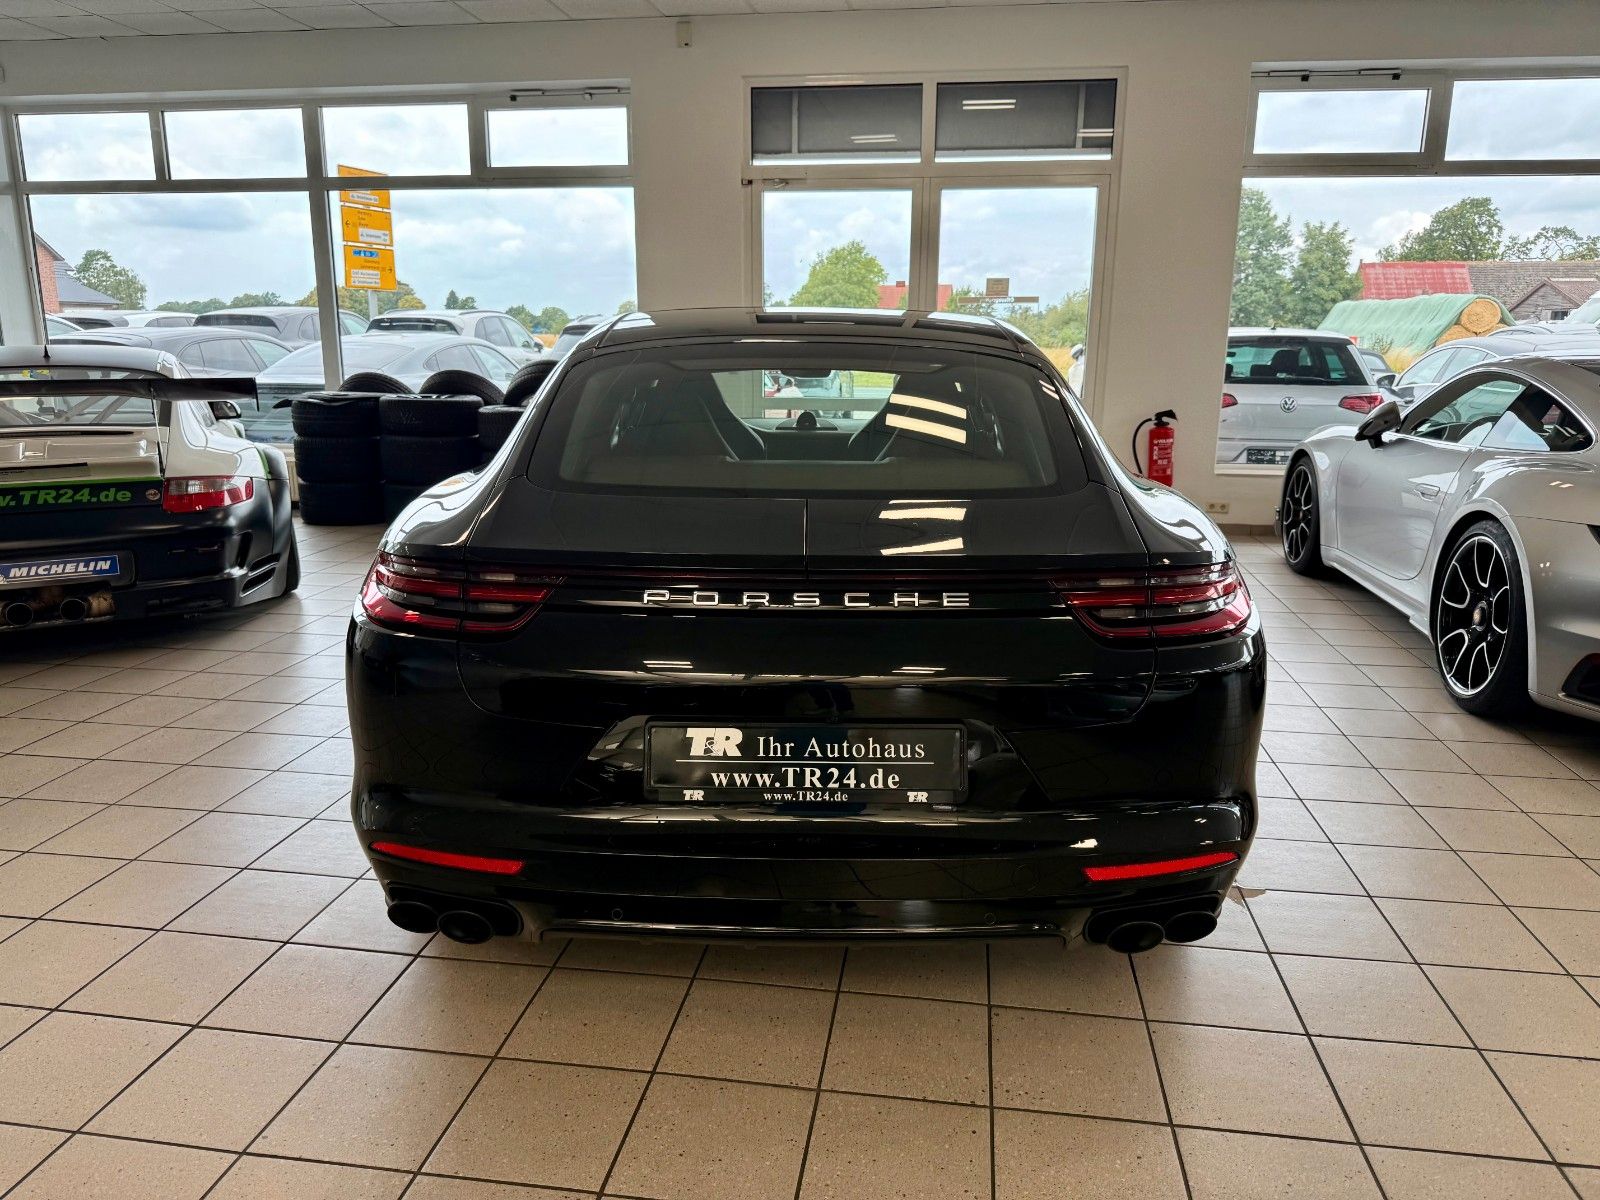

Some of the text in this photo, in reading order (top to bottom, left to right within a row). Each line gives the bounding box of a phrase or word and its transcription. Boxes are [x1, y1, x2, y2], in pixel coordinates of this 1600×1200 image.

[9, 560, 111, 578] MICHELIN
[643, 589, 970, 607] PORSCHE
[757, 736, 925, 759] Ihr Autohaus
[711, 767, 900, 789] www.TR24.de
[763, 790, 848, 802] www.TR24.de
